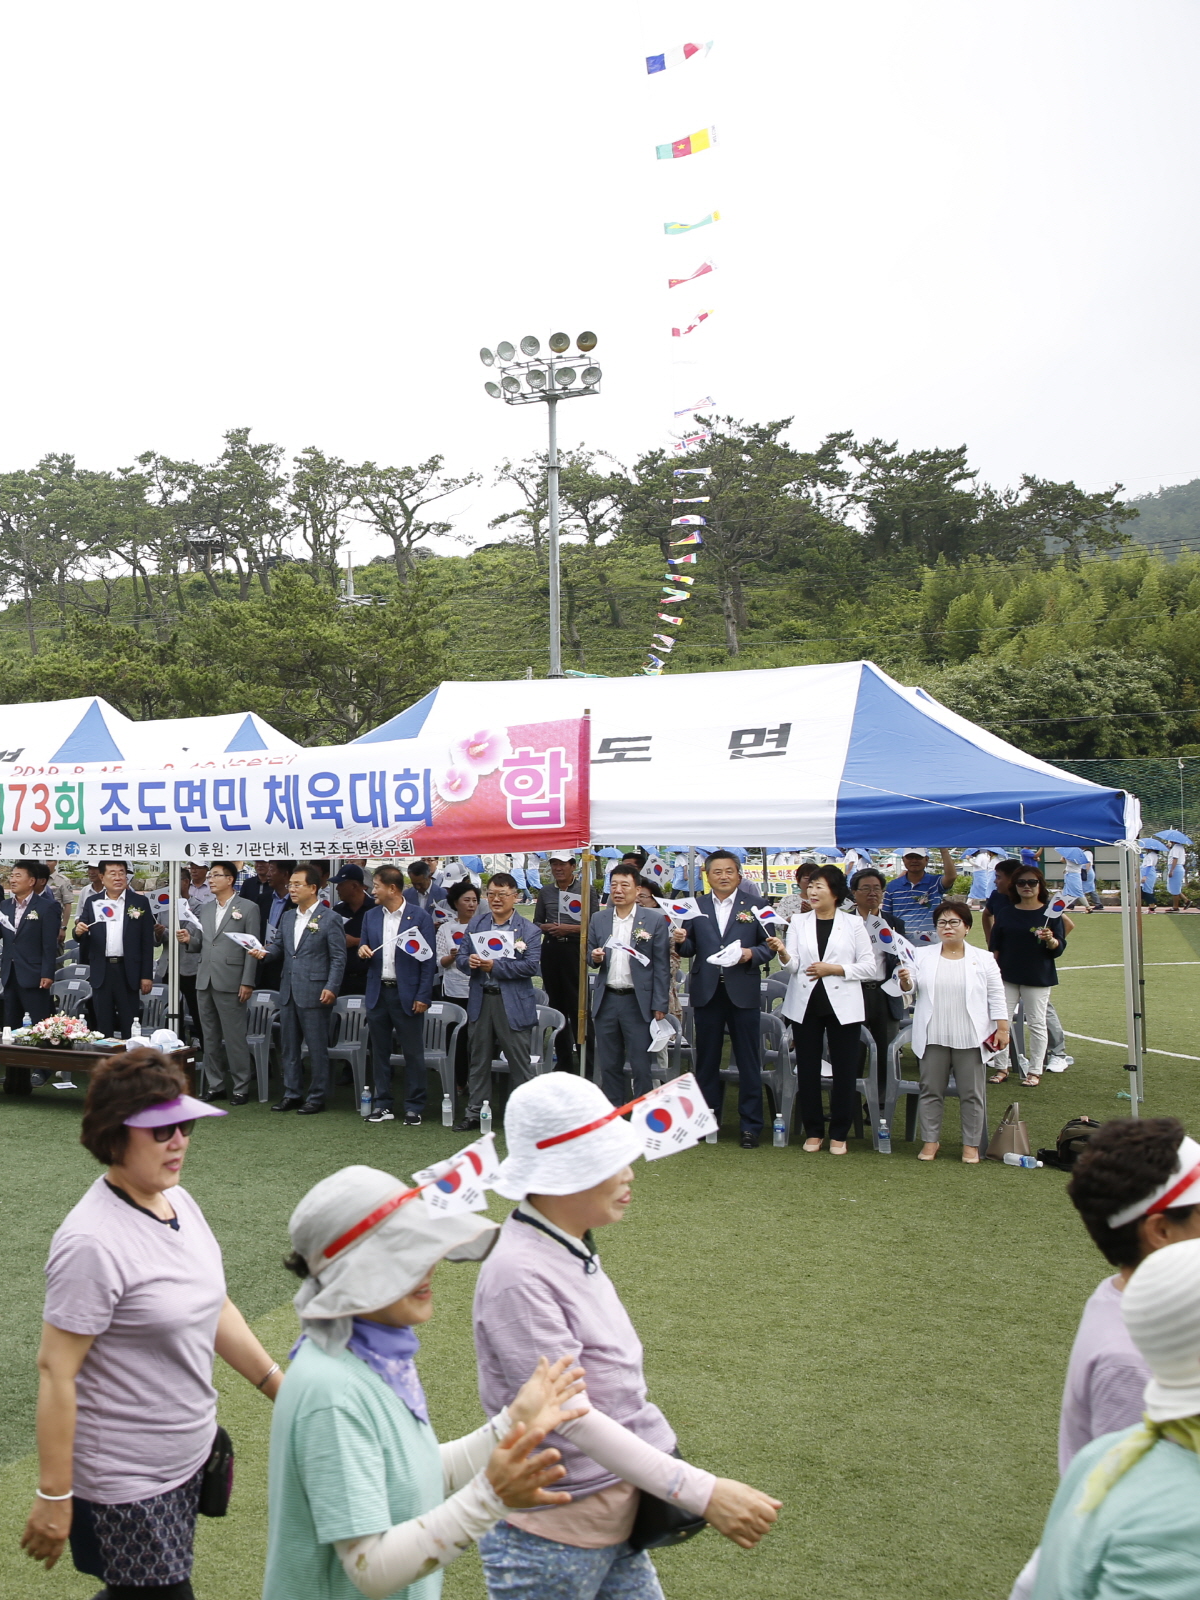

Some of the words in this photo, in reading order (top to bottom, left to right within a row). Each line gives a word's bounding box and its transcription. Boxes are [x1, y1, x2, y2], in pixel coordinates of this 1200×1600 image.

[100, 777, 251, 832] 조도면민
[263, 768, 434, 829] 체육대회
[501, 748, 571, 828] 합
[86, 843, 161, 857] 조도면체육회
[300, 839, 414, 856] 전국조도면향우회
